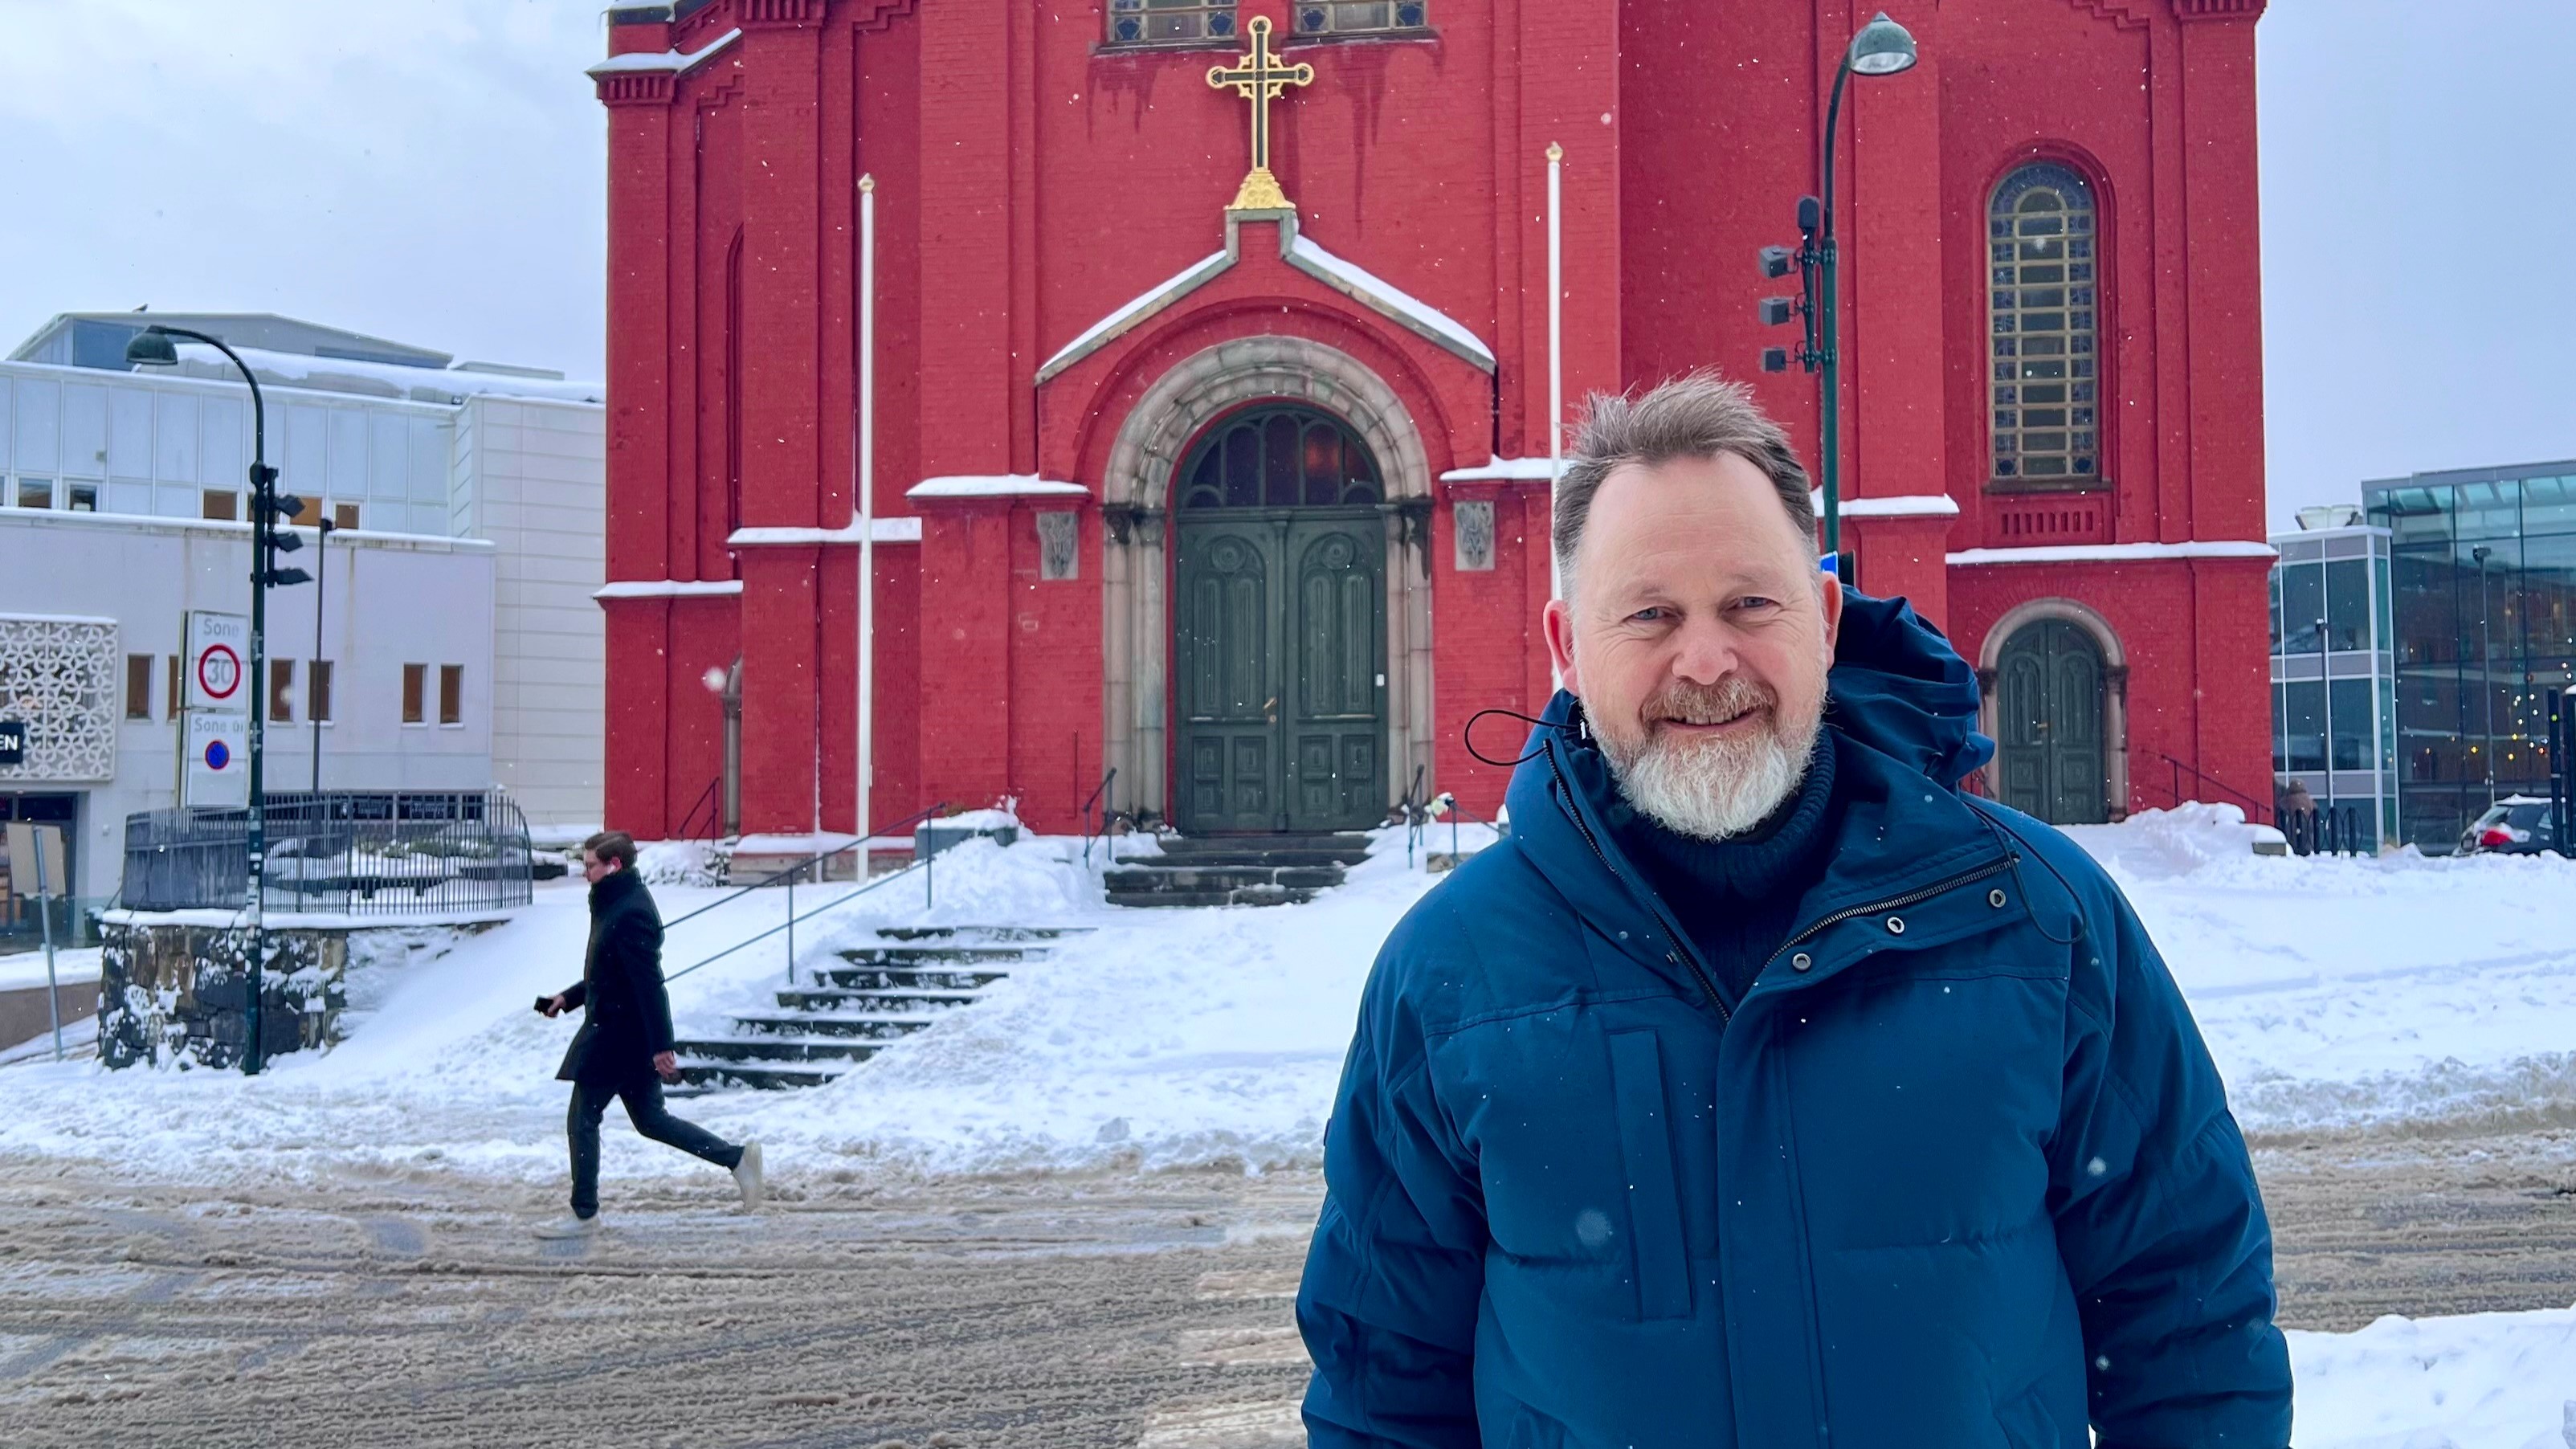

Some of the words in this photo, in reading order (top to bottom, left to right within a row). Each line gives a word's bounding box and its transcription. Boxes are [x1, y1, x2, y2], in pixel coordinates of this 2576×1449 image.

[203, 618, 239, 638] Sone
[207, 658, 233, 684] 30
[194, 716, 227, 733] Sone
